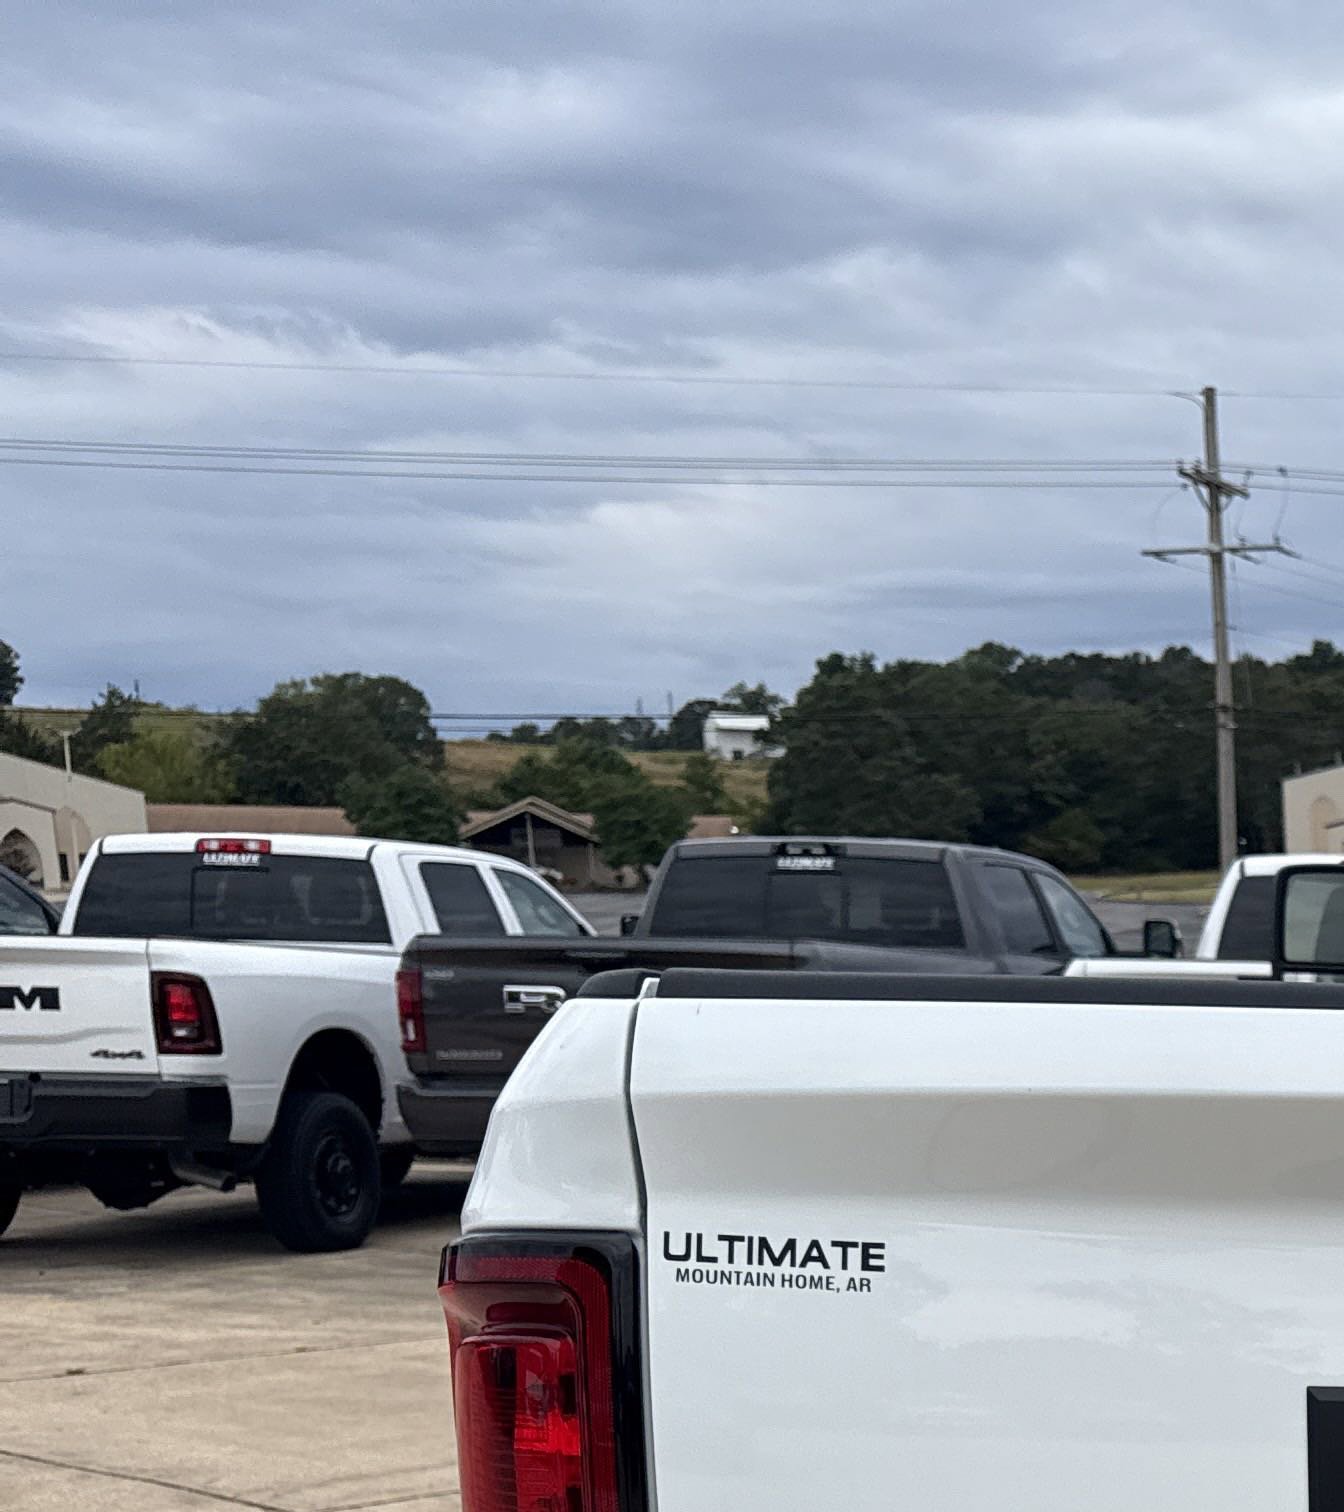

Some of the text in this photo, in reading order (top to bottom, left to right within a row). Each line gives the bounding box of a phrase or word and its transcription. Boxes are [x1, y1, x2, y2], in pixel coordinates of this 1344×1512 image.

[663, 1231, 886, 1272] ULTIMATE
[675, 1267, 872, 1293] MOUNTAIN HOME, AR
